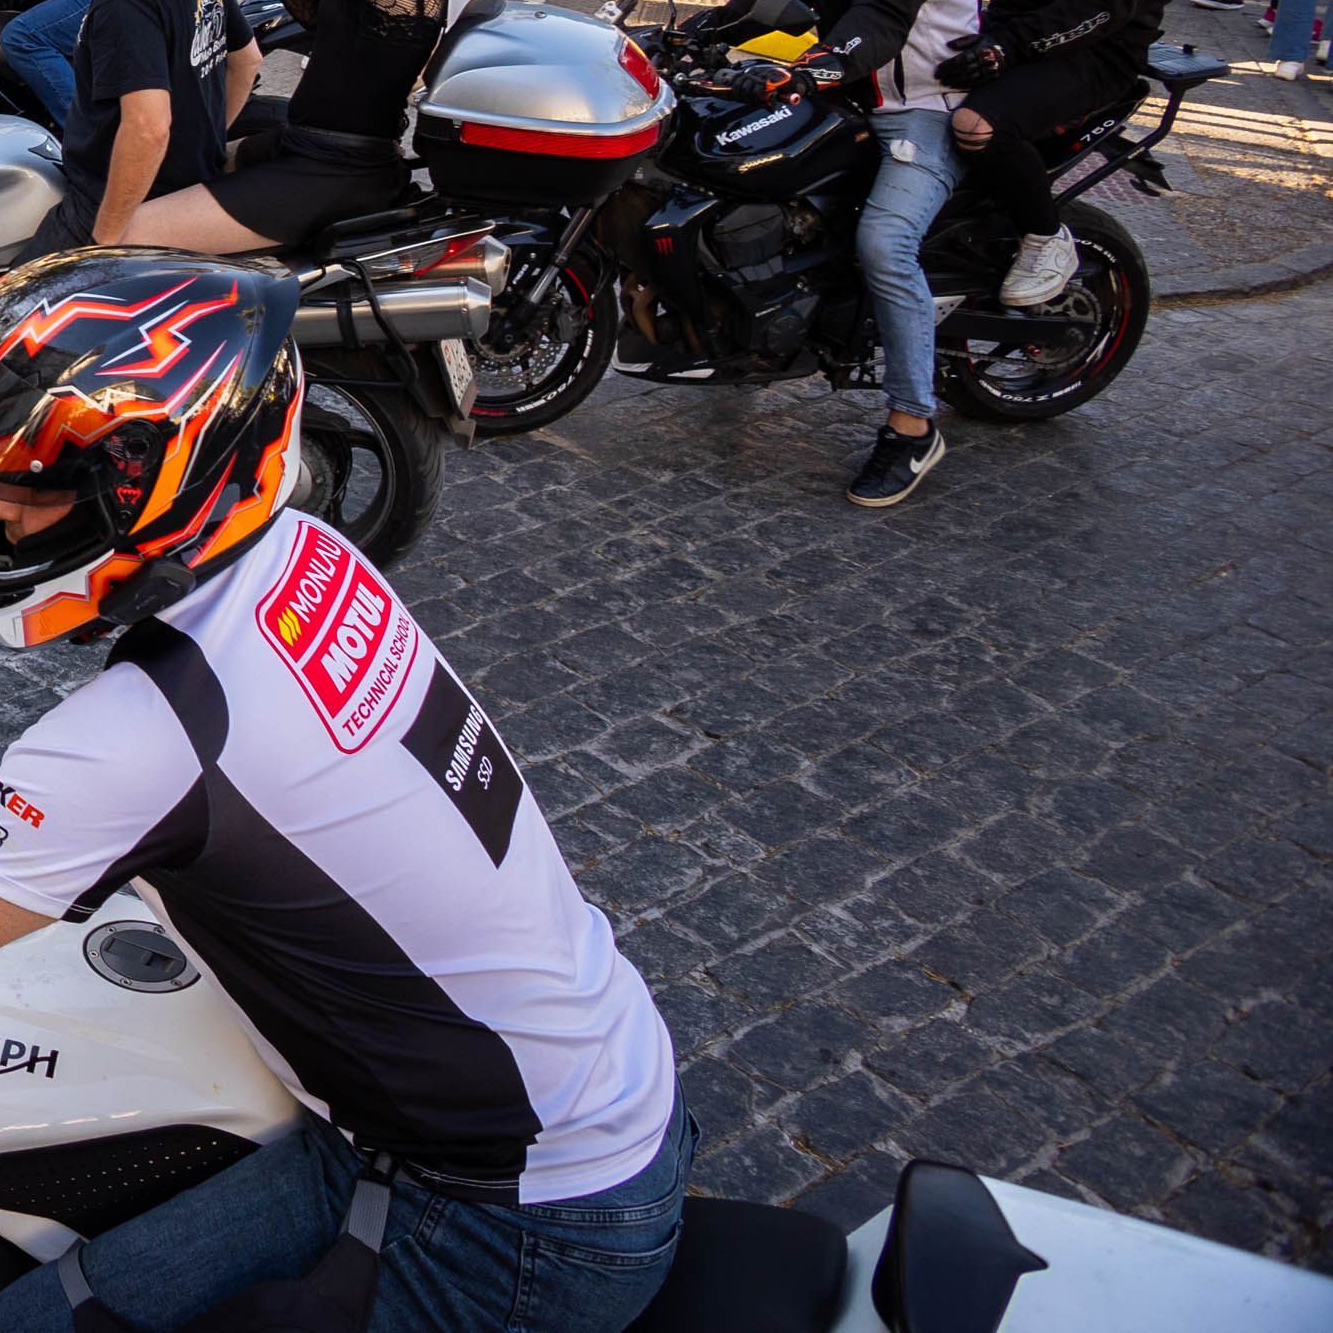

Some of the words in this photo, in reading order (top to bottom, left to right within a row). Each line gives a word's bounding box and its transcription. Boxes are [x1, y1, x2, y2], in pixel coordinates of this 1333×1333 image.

[716, 105, 793, 147] Kawasaki
[288, 532, 342, 624] MONLAU
[320, 582, 386, 694] MOTUL
[342, 663, 400, 738] TECHNICAL
[394, 617, 410, 664] SCHOOL
[445, 704, 483, 792] SAMSUNG
[478, 755, 493, 790] SSD
